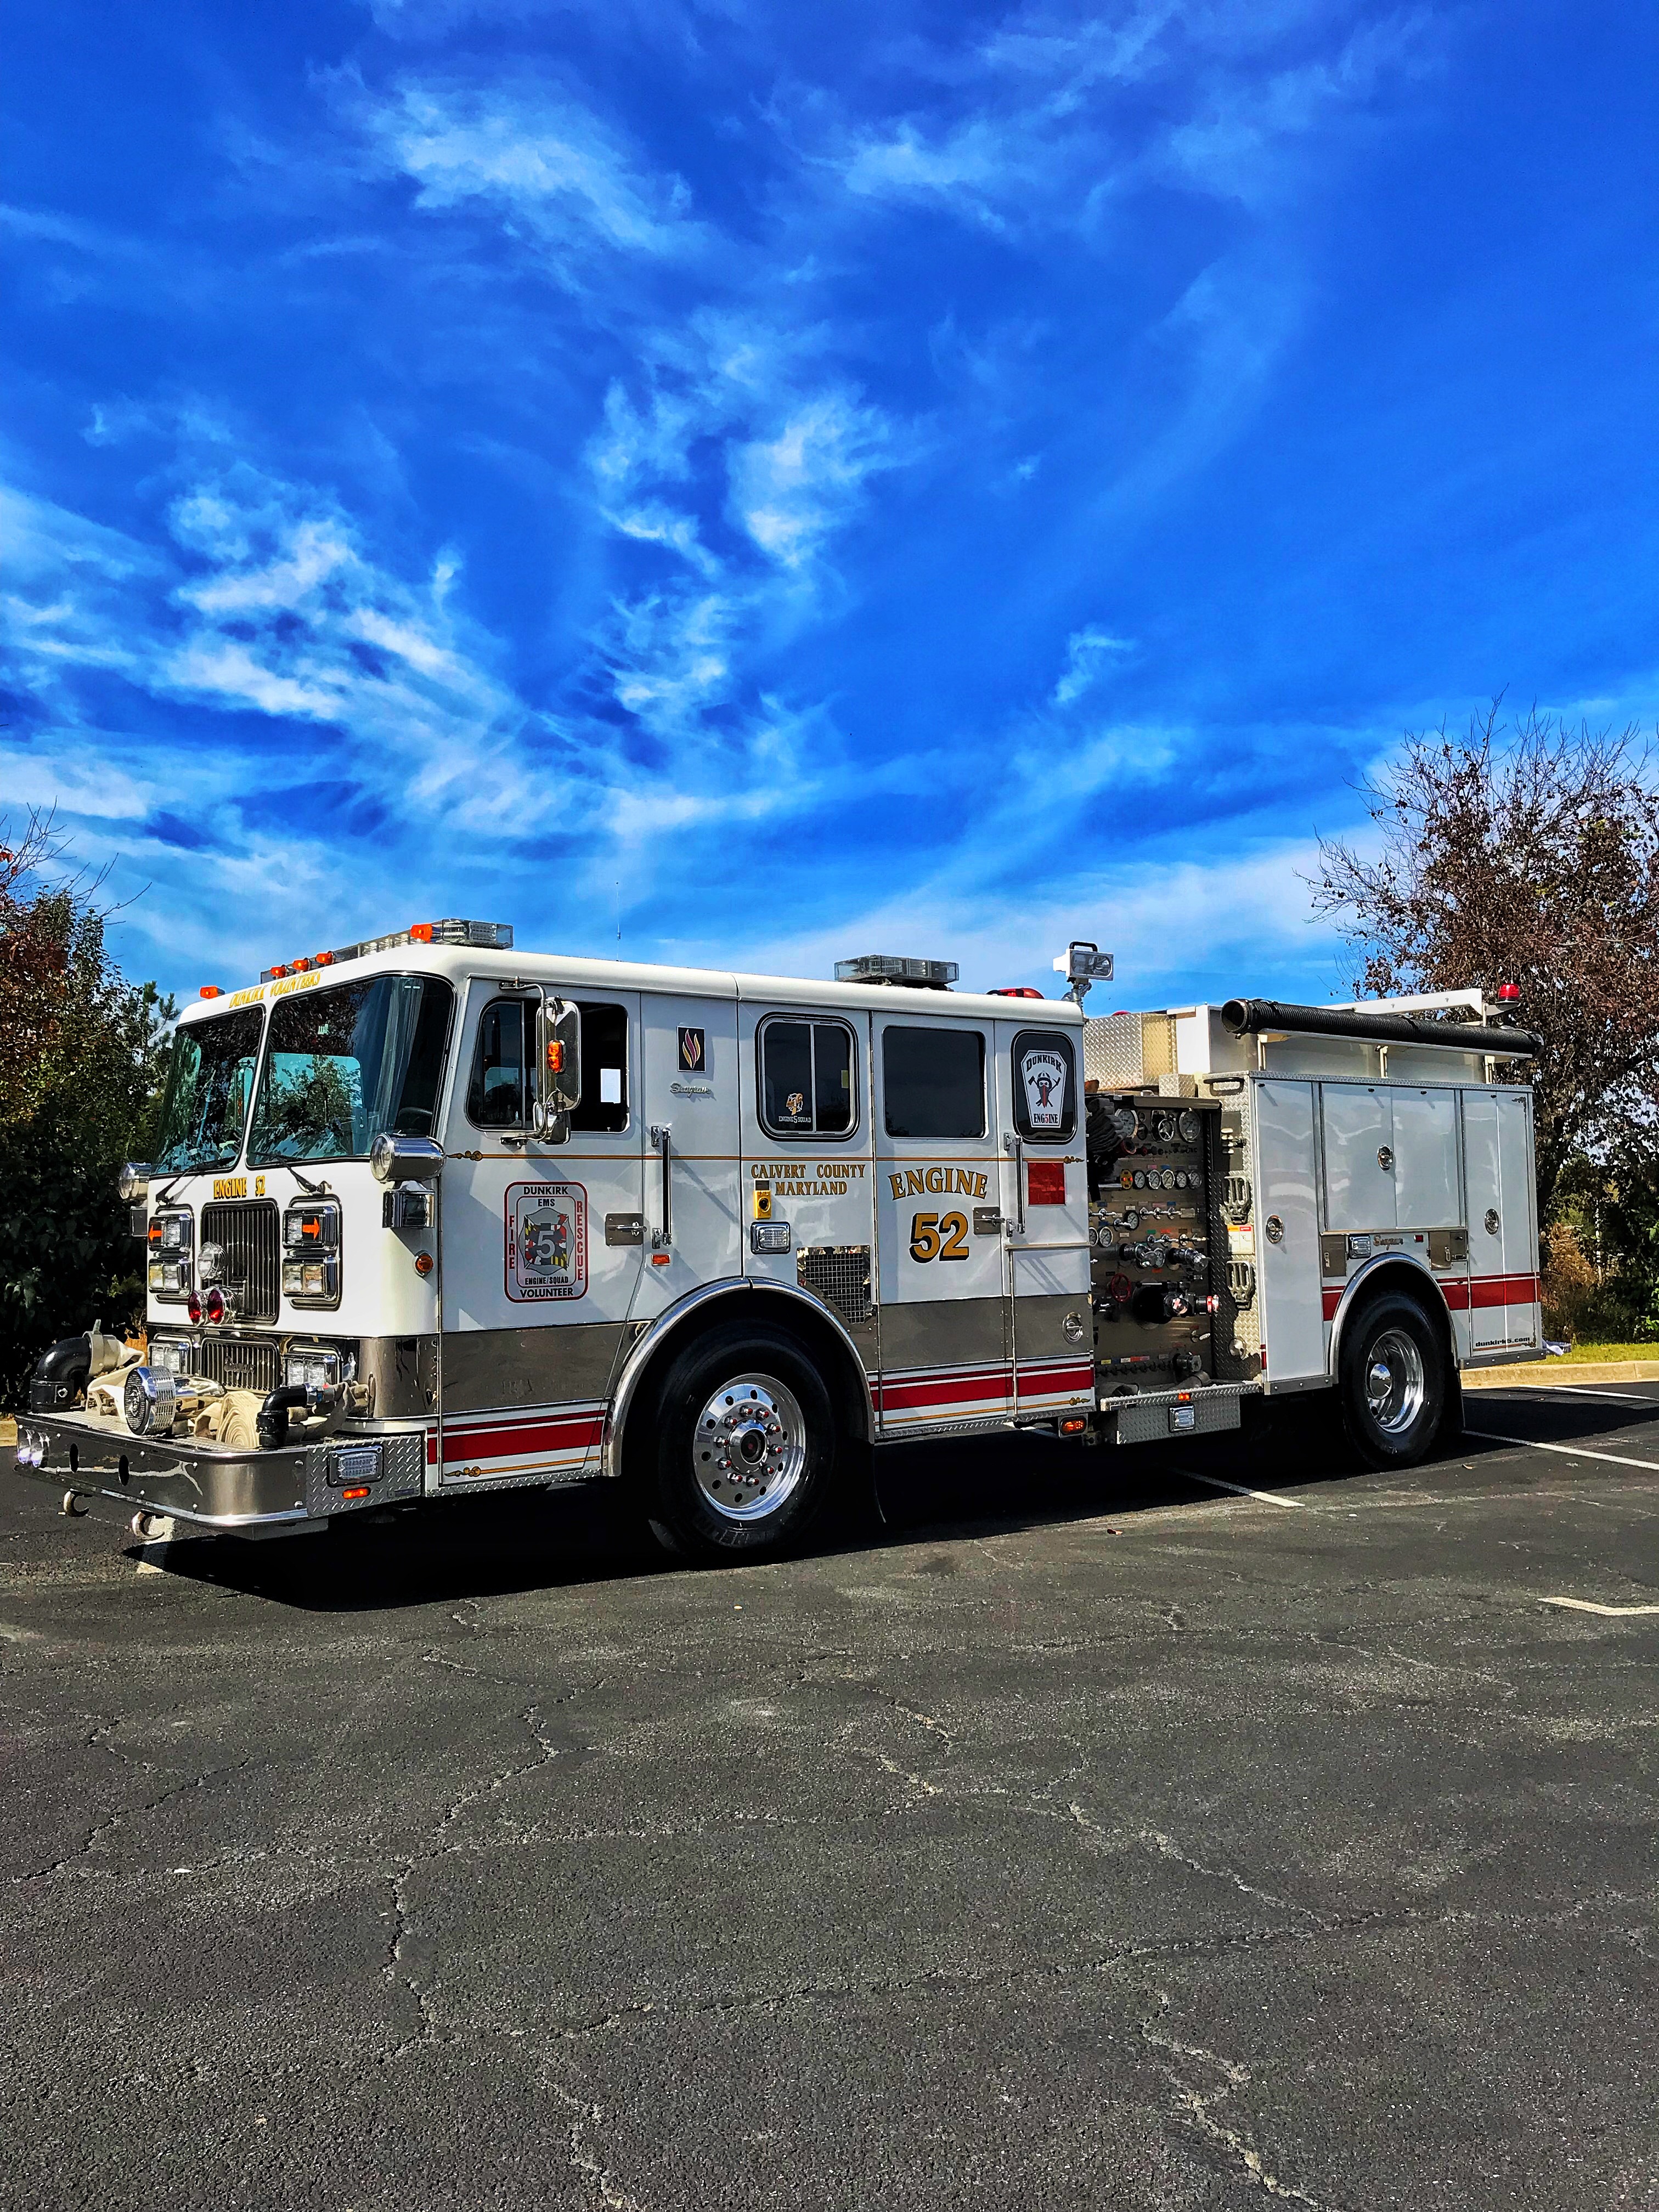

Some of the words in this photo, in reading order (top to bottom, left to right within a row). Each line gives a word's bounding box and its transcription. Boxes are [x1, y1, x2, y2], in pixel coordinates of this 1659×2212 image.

[1026, 1054, 1062, 1074] DUNKIRK
[751, 1164, 806, 1178] CALVERT
[816, 1164, 866, 1178] COUNTY
[213, 1177, 247, 1199] ENGINE
[255, 1175, 266, 1197] 52
[523, 1186, 568, 1195] DUNKIRK
[775, 1181, 847, 1195] MARYLAND
[888, 1167, 988, 1200] ENGINE
[538, 1198, 555, 1207] EMS
[537, 1230, 555, 1259] 5
[909, 1211, 969, 1263] 52
[520, 1288, 574, 1298] VOLUNTEER
